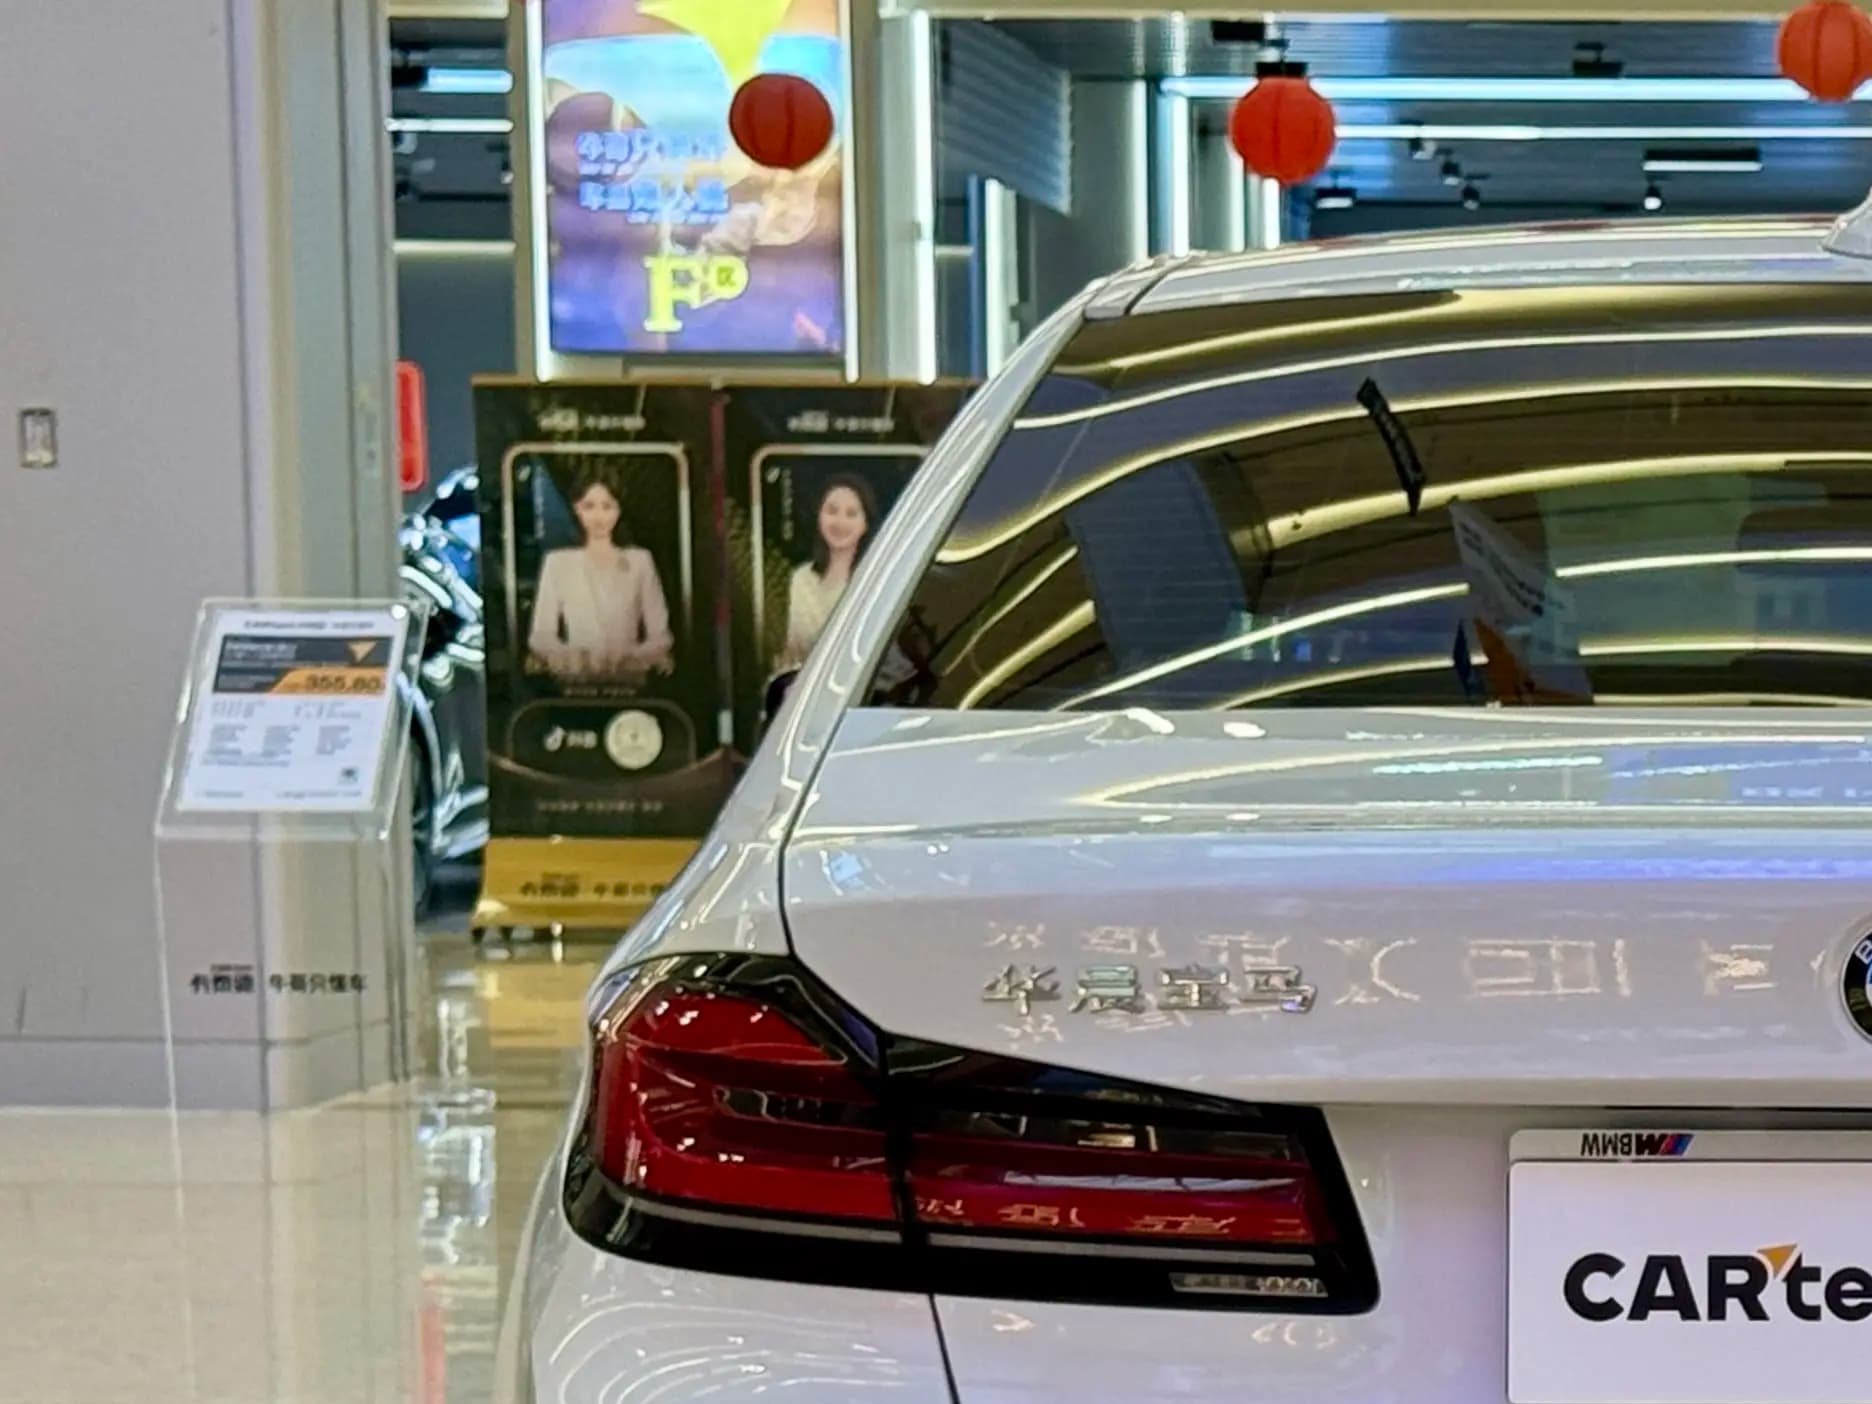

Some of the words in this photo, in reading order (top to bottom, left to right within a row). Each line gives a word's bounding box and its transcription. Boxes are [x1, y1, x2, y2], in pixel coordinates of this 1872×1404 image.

[982, 963, 1318, 1015] 华晨宝马
[1580, 1132, 1633, 1157] BMW
